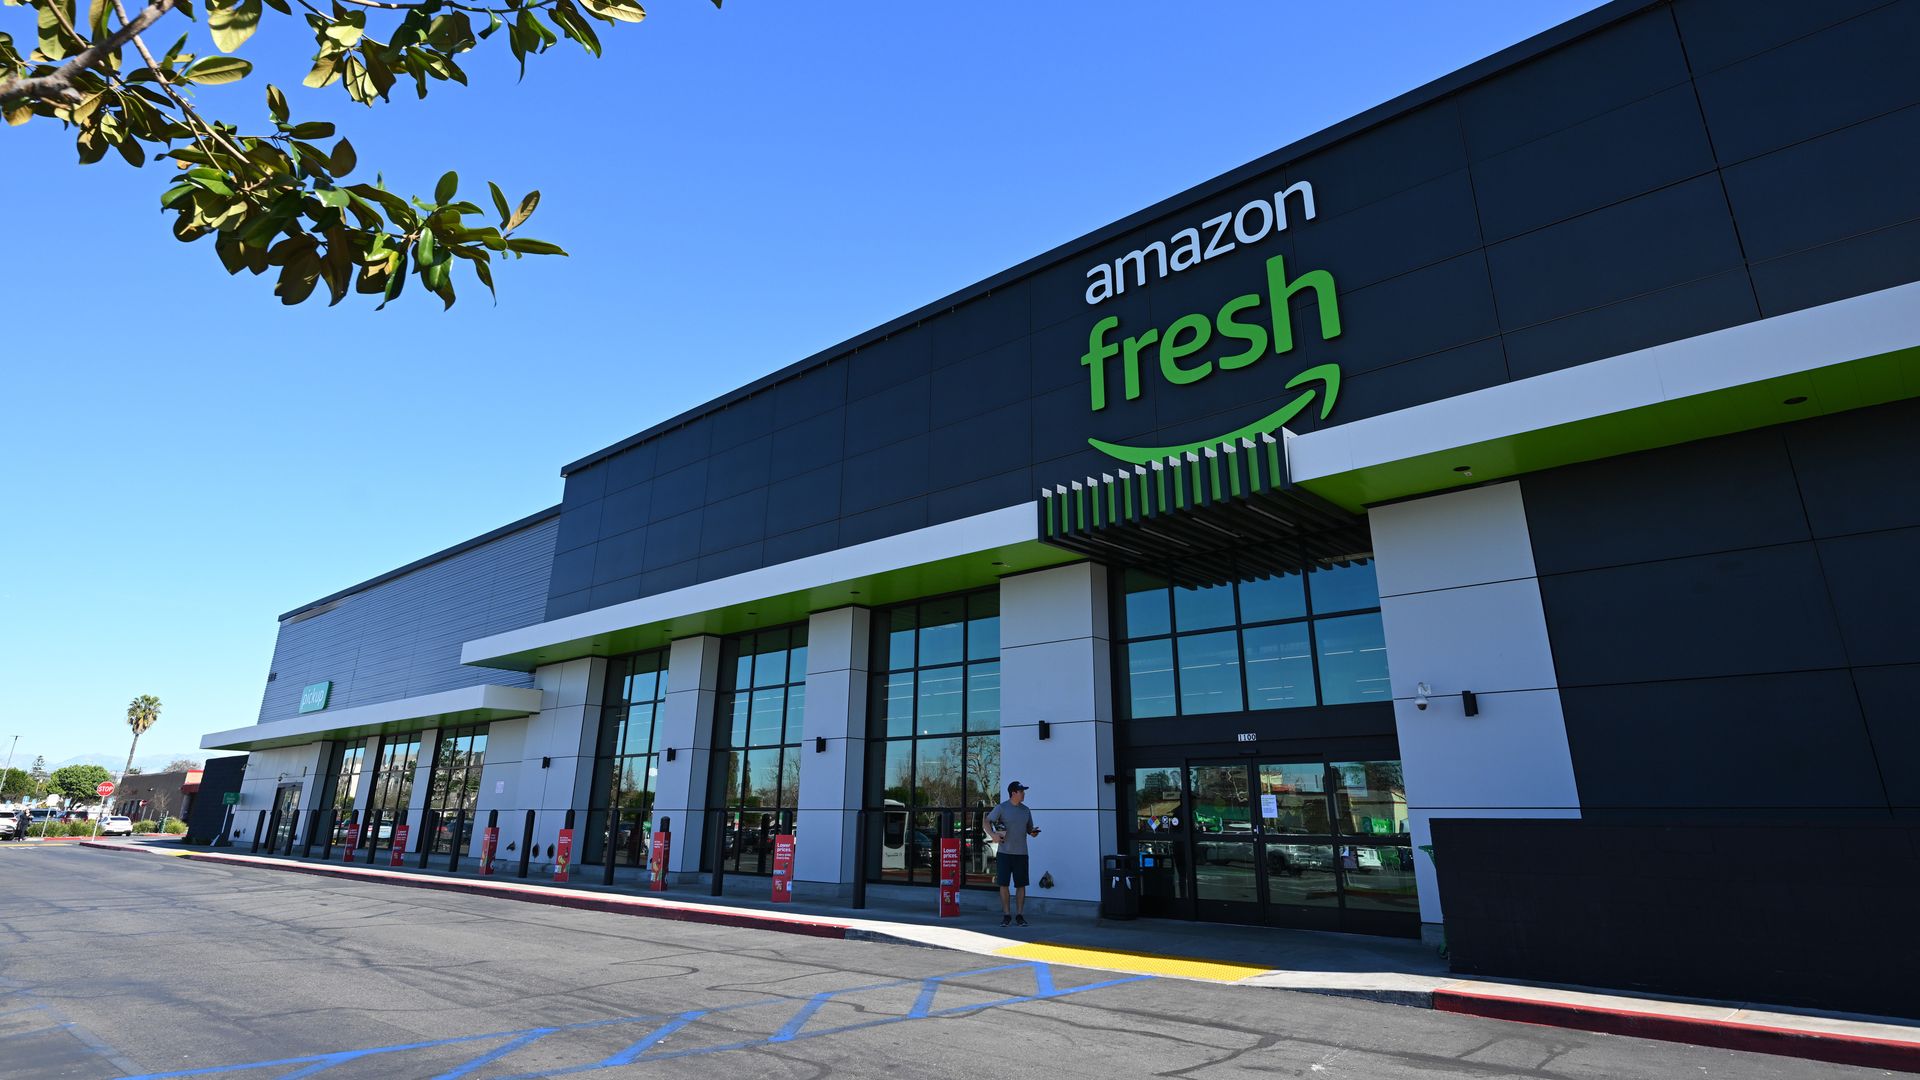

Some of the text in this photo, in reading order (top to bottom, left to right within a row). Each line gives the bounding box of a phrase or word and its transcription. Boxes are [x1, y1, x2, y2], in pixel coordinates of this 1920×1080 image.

[1085, 180, 1316, 305] amazon
[1080, 254, 1342, 411] fresh
[302, 687, 325, 706] pickup
[1239, 733, 1256, 741] 1100
